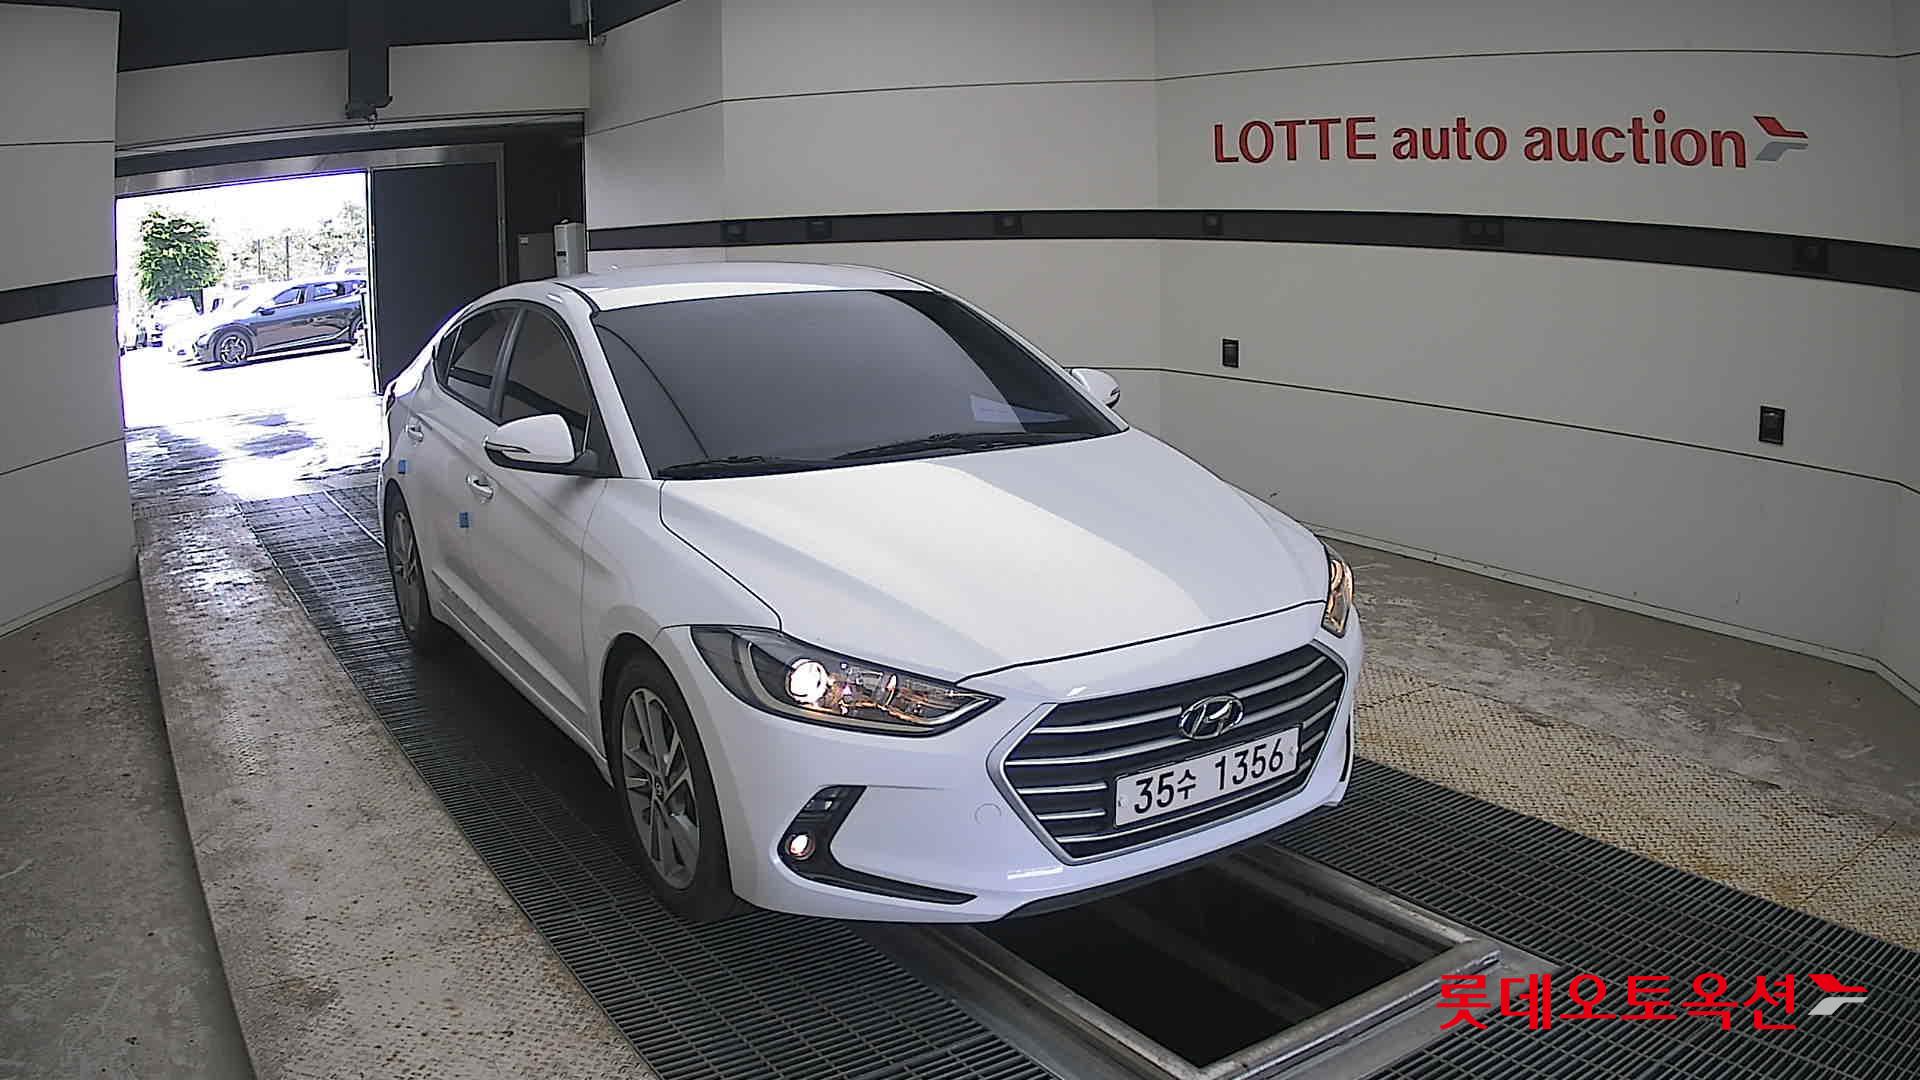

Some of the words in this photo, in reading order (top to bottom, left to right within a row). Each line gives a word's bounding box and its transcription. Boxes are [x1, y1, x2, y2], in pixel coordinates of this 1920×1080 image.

[1213, 116, 1377, 163] LOTTE
[1392, 117, 1508, 161] auto
[1524, 109, 1748, 169] auction
[1133, 769, 1197, 814] 35수
[1214, 738, 1284, 790] 1356
